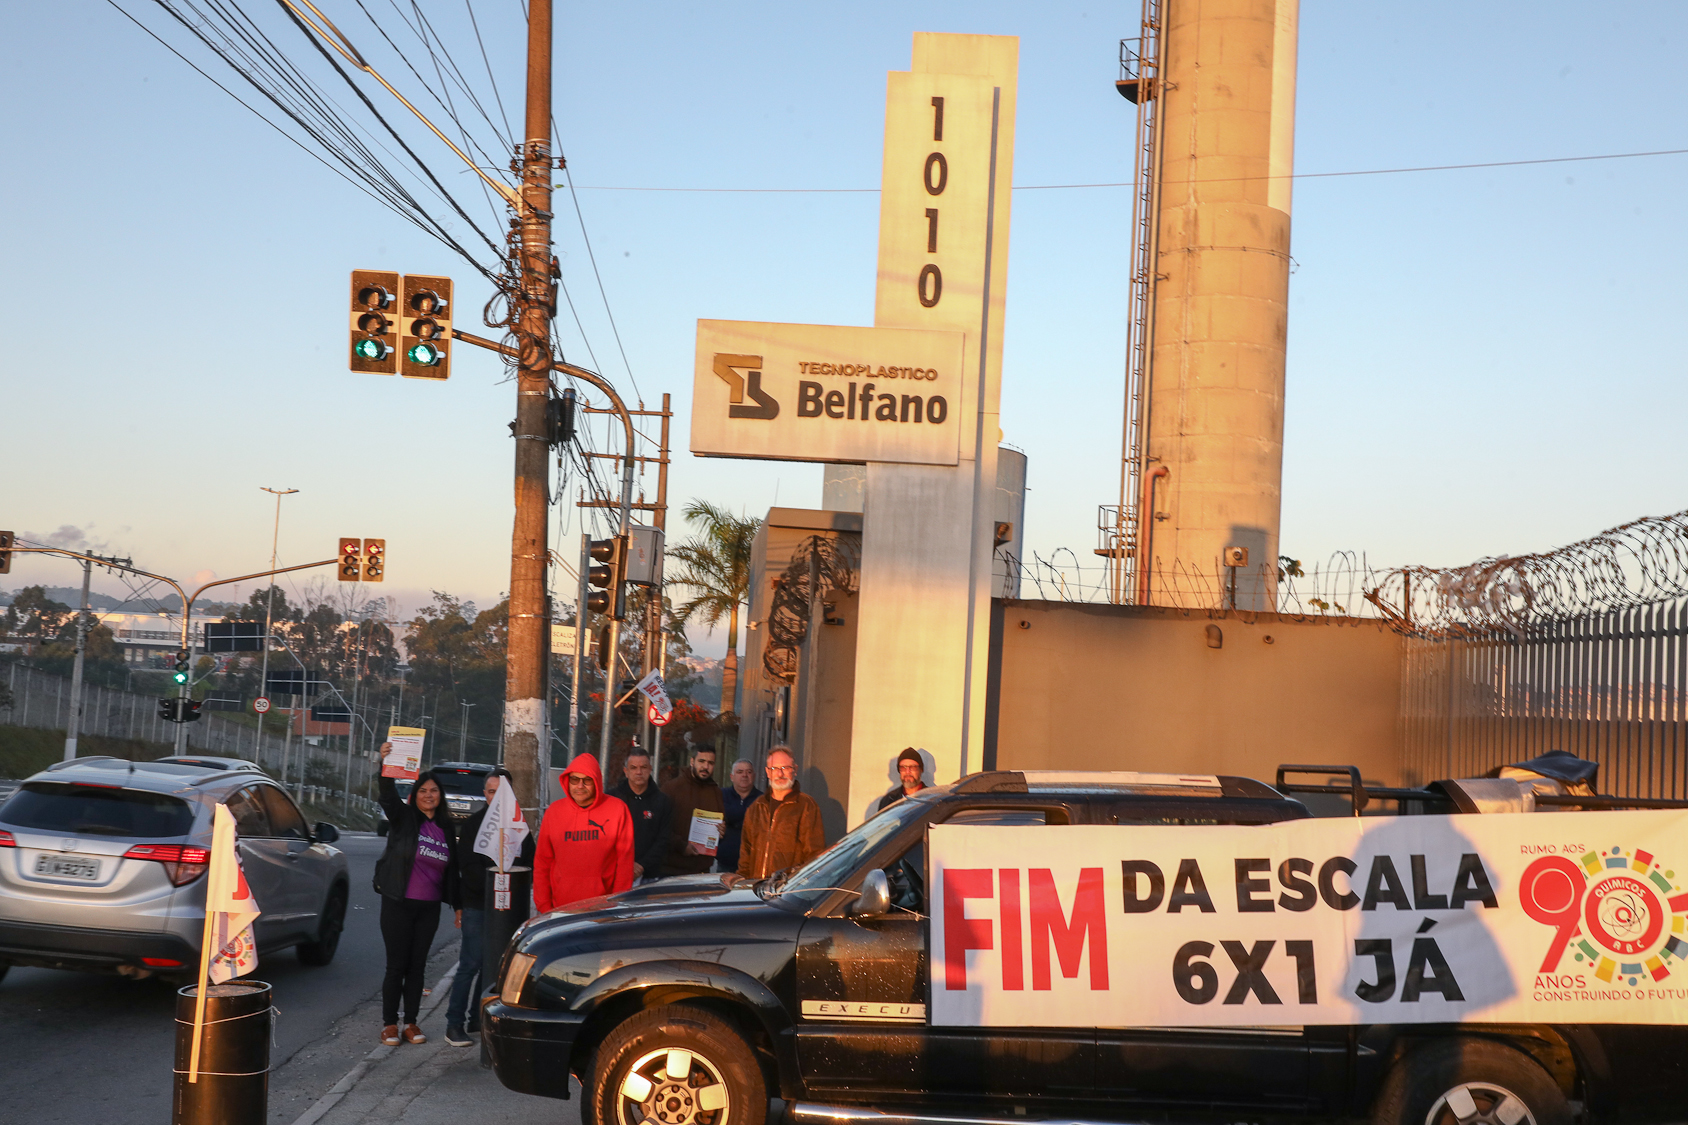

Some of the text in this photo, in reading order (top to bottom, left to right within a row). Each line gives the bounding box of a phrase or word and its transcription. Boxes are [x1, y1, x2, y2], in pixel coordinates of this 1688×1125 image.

[918, 96, 948, 308] 1010
[798, 361, 938, 381] TECNOPLASTICO
[797, 380, 948, 424] Belfano
[256, 700, 268, 708] 50
[564, 829, 599, 842] PUMA
[1520, 843, 1586, 855] RUMO AOS
[943, 853, 1499, 991] FIM DA ESCALA
[1172, 917, 1466, 1005] 6X1 JÁ
[1534, 975, 1586, 990] ANOS
[1533, 988, 1688, 1002] CONSTRUINDO O FUTU
[819, 1003, 926, 1015] EXECU
